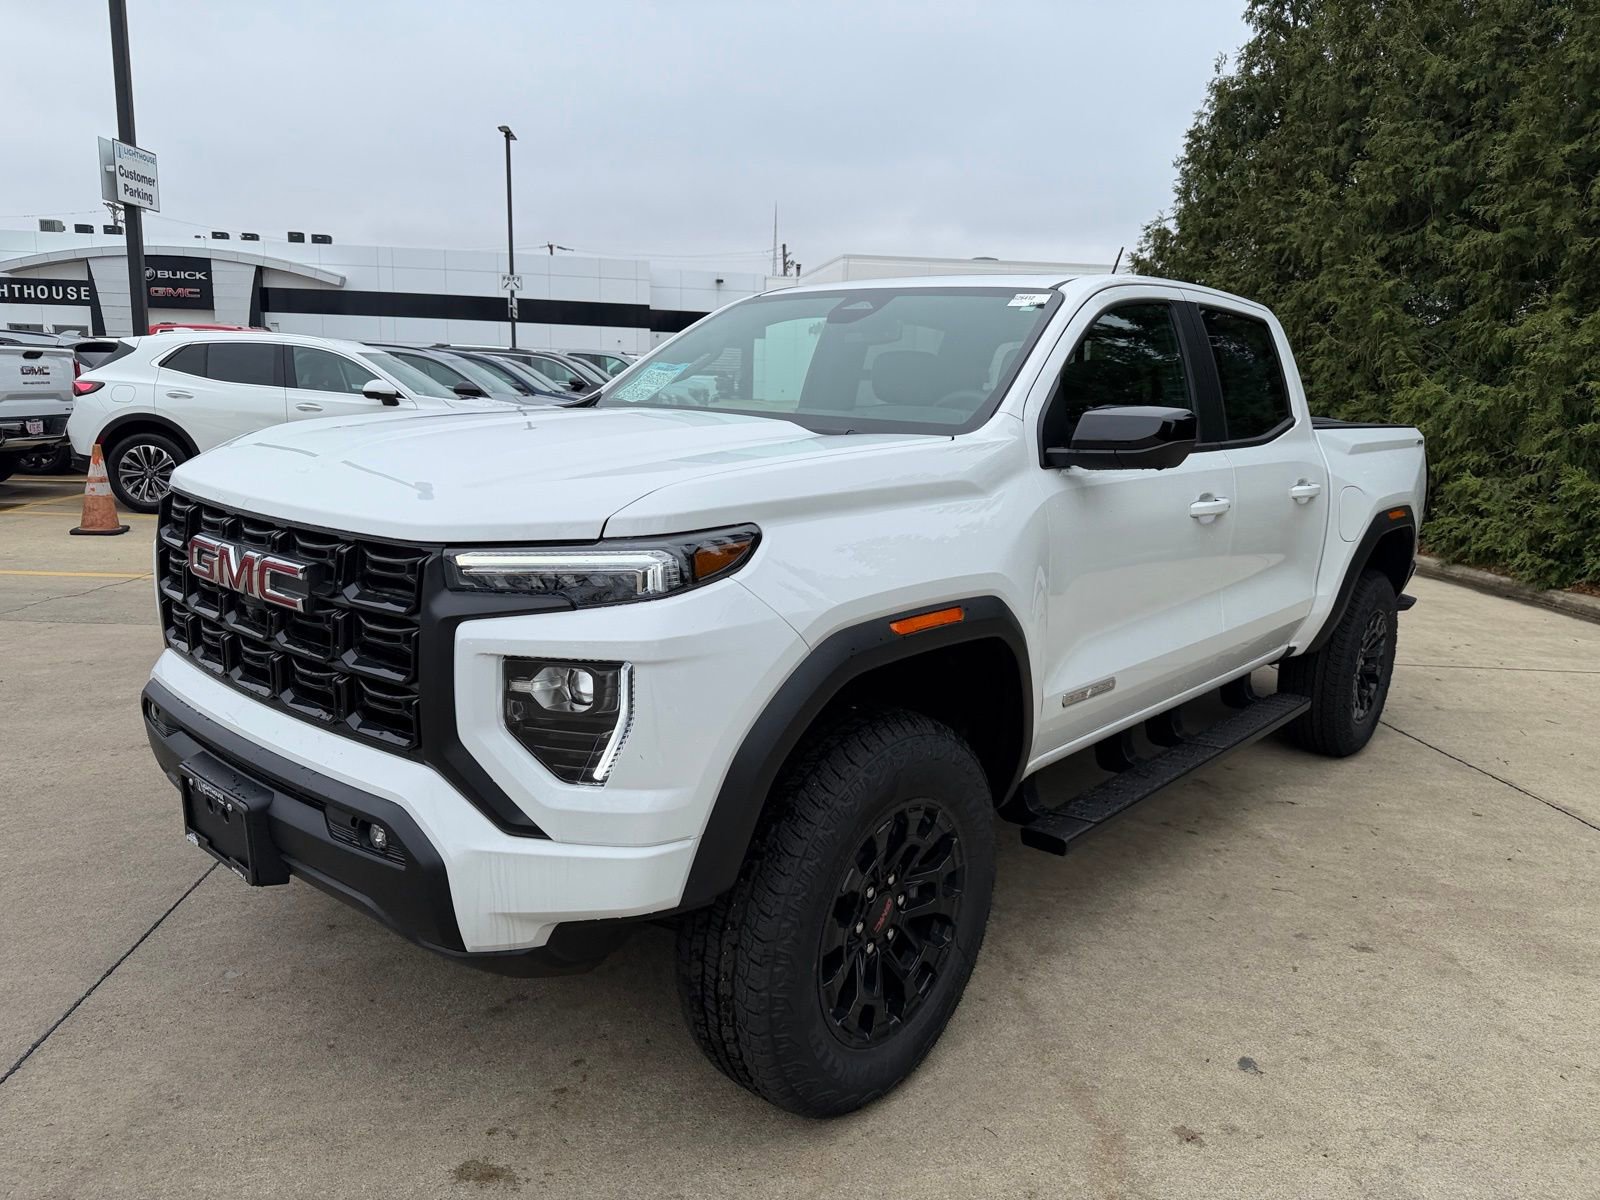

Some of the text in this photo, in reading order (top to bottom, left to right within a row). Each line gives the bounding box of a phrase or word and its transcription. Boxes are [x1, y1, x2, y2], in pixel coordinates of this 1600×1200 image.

[123, 147, 157, 165] LIGHTHOUSE
[118, 164, 156, 187] Customer
[123, 183, 154, 206] Parking
[157, 270, 208, 280] BUICK
[0, 284, 91, 300] HTHOUSE
[150, 286, 201, 298] GMC
[21, 366, 50, 376] GMC
[188, 534, 304, 613] GMC
[873, 897, 893, 933] GMC
